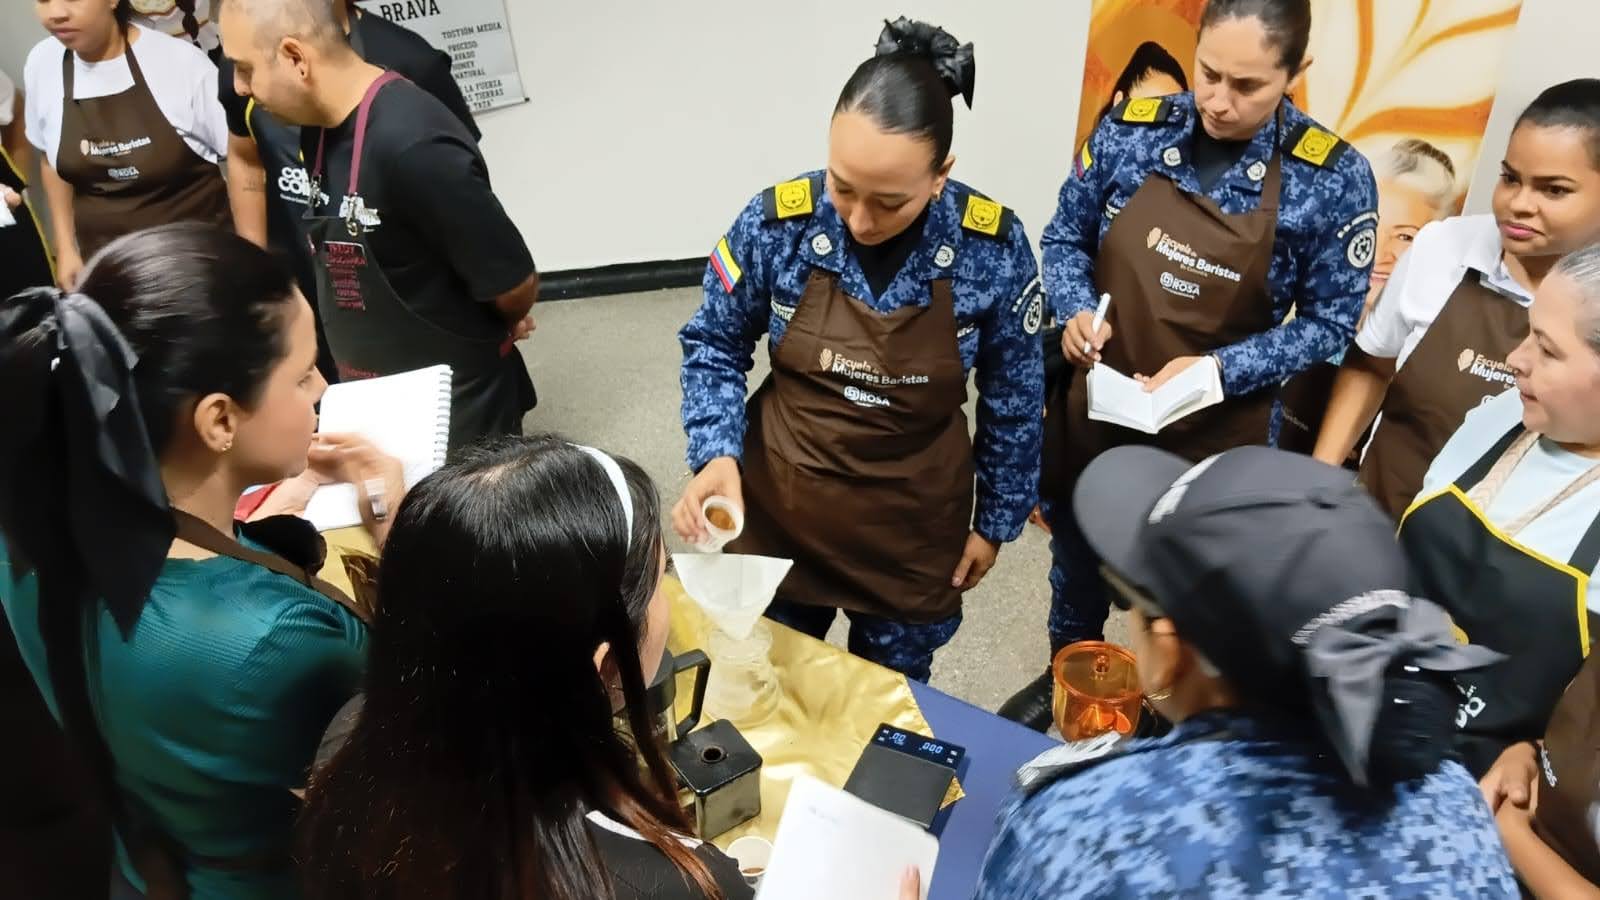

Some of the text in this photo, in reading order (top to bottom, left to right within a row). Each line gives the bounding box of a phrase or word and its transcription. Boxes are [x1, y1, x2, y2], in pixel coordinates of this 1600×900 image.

[380, 0, 441, 22] BRAVA
[476, 22, 502, 32] MEDIA
[453, 50, 476, 61] AVADO
[455, 69, 486, 79] NATURAL
[474, 88, 504, 99] TIERRAS
[1155, 240, 1196, 267] Mujeres
[1196, 258, 1241, 282] Baristas
[1171, 281, 1200, 296] ROSA
[833, 353, 872, 372] Escuela
[832, 362, 880, 383] Mujeres
[881, 375, 929, 385] Baristas
[860, 391, 891, 407] ROSA
